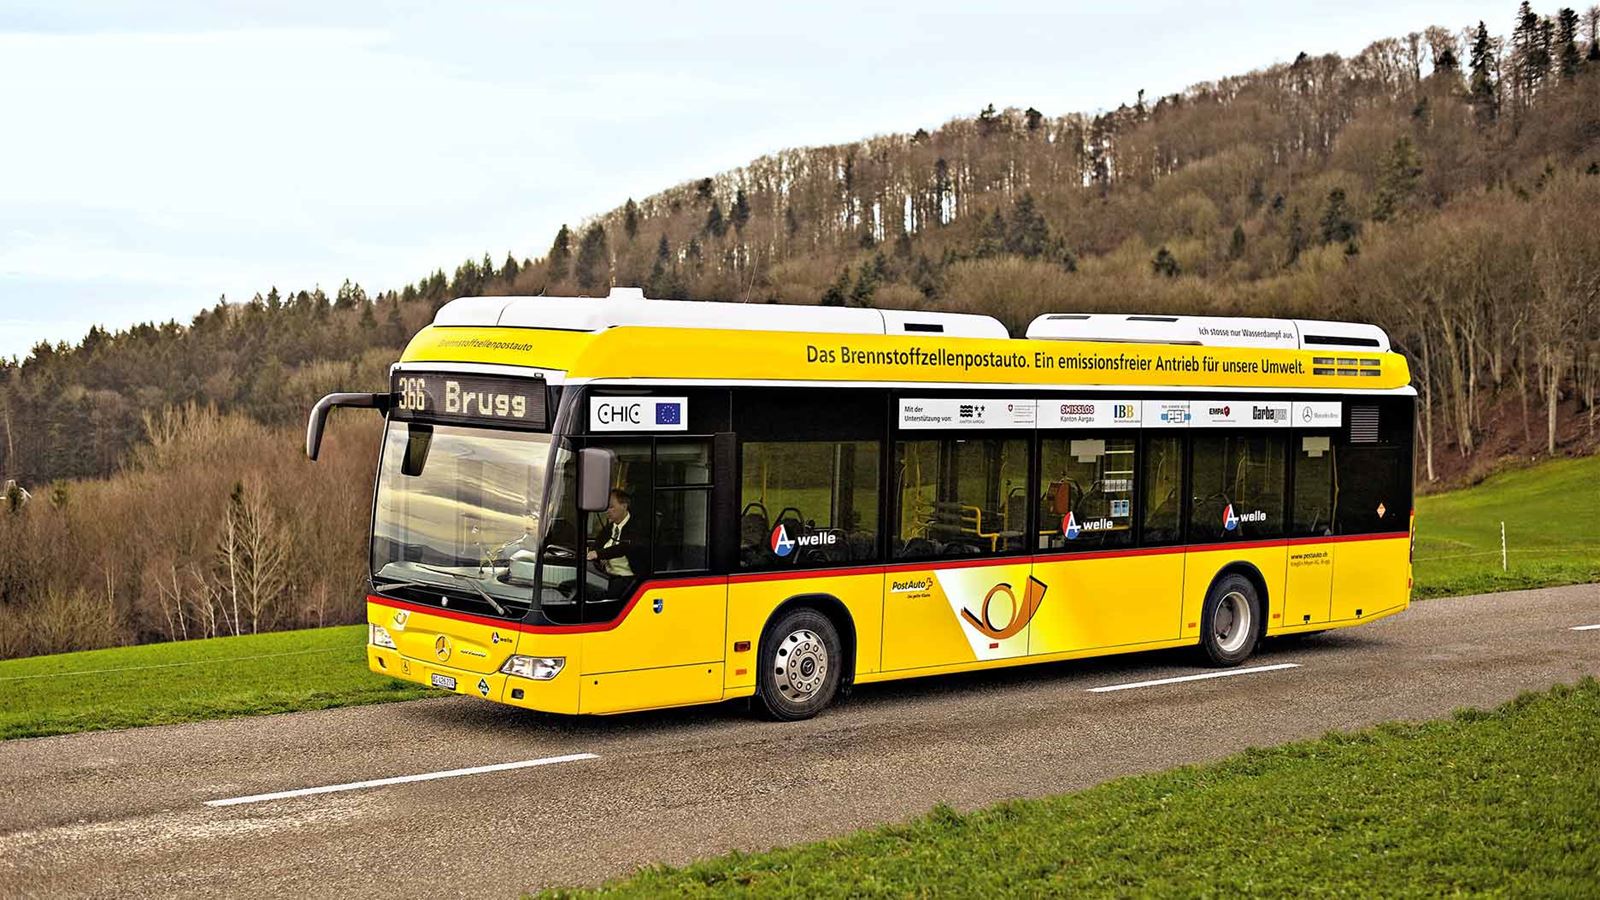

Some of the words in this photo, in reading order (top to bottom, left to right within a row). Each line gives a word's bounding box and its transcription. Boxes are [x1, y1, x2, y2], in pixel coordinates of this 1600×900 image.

[1199, 327, 1209, 336] Ich
[1210, 328, 1229, 336] stosse
[1242, 329, 1282, 340] Wasserdampf
[806, 345, 836, 364] Das
[841, 346, 1030, 370] Brennstoffzellenpostauto.
[1034, 352, 1054, 369] Ein
[1058, 353, 1152, 371] emissionsfreier
[1155, 355, 1200, 372] Antrieb
[1202, 357, 1220, 372] für
[1222, 360, 1258, 374] unsere
[1261, 359, 1306, 375] Umwelt.
[398, 377, 425, 411] 366
[445, 381, 526, 418] Brugg
[1060, 404, 1094, 414] SWISSLOS
[1114, 404, 1134, 418] IBB
[904, 415, 940, 424] Unterstützung
[1167, 410, 1186, 424] PSI
[1240, 510, 1266, 522] welle
[1083, 518, 1114, 530] welle
[798, 532, 836, 546] welle
[892, 580, 926, 590] PostAuto
